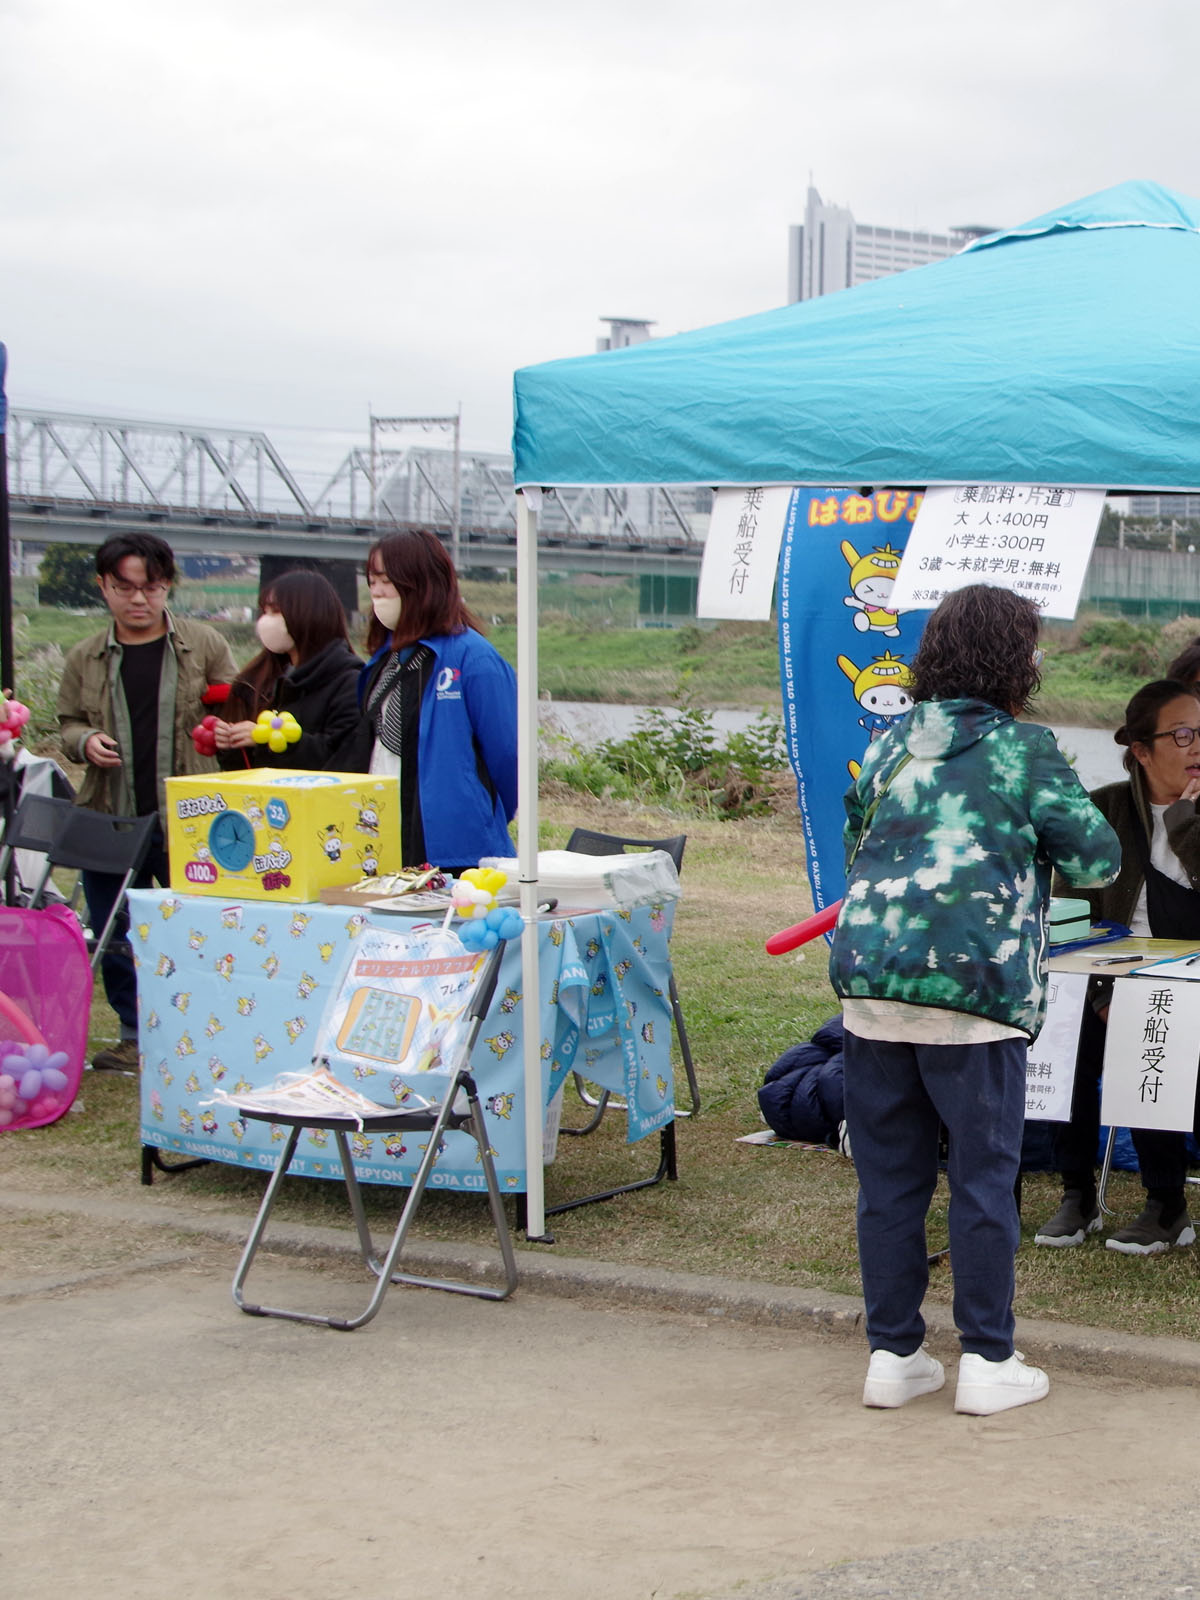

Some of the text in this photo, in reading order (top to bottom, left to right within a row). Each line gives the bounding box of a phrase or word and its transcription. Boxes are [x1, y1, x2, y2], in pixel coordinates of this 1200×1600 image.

[789, 505, 798, 526] CITY
[730, 487, 764, 595] 乗船受付
[786, 526, 795, 543] OTA
[945, 533, 1045, 552] 小学生：300円
[783, 545, 792, 576] TOKYO
[782, 577, 790, 599] CITY
[782, 599, 790, 619] OTA
[782, 622, 792, 655] TOKYO
[784, 657, 794, 679] CITY
[786, 680, 795, 700] OTA
[788, 702, 798, 735] TOKYO
[791, 737, 799, 759] CITY
[799, 782, 810, 812] TOKYO
[804, 816, 813, 837] CITY
[809, 839, 818, 857] OTA
[812, 861, 823, 890] TOKYO
[1139, 988, 1175, 1104] 乗船受付
[432, 1174, 460, 1187] OTA
[463, 1175, 487, 1188] CIT
